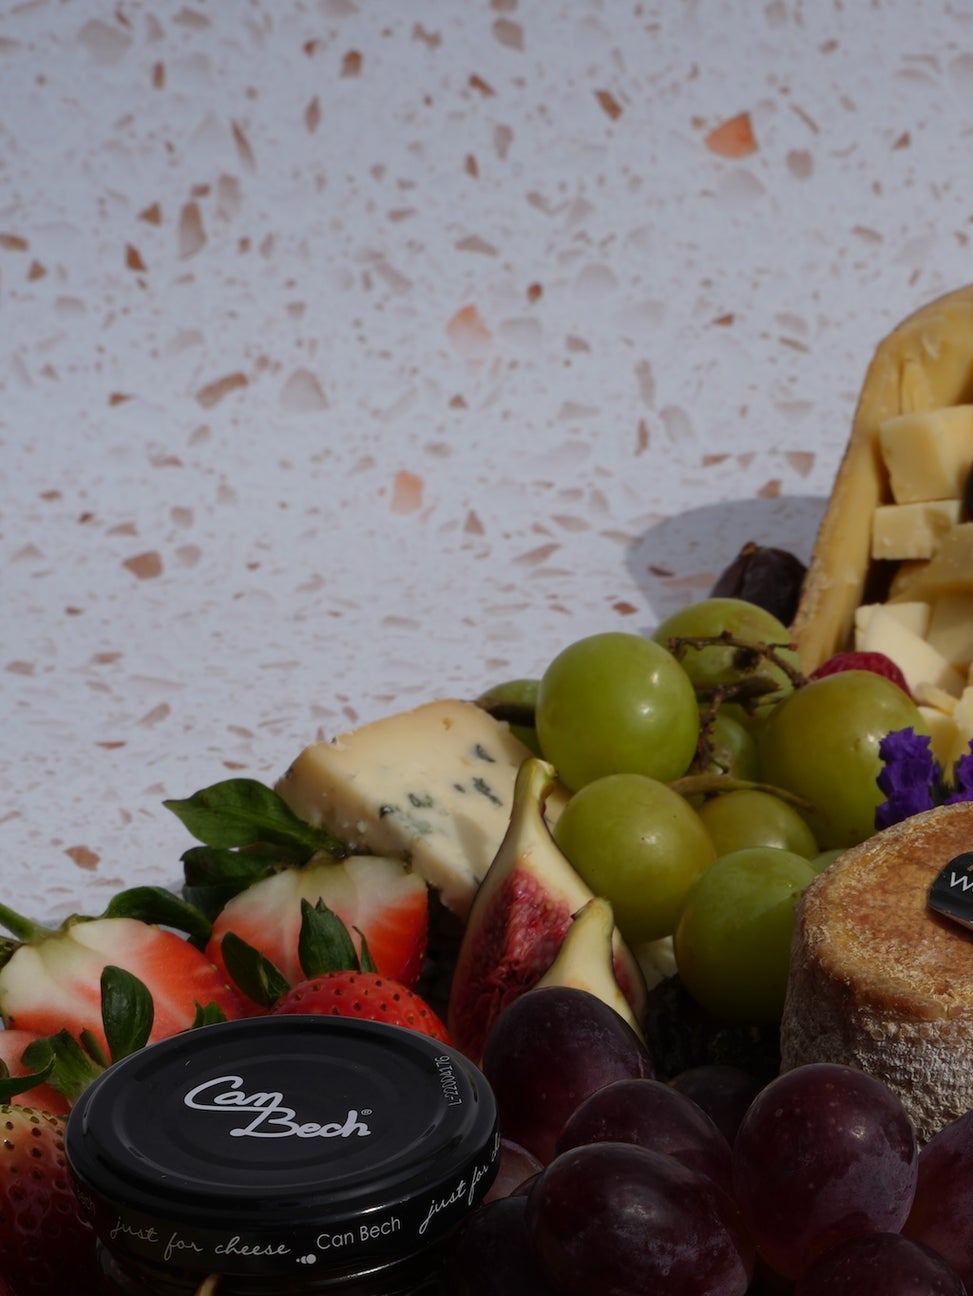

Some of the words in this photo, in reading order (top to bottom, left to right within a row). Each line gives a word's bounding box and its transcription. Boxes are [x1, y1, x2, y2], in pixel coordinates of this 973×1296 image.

[183, 1074, 284, 1113] Can
[110, 1217, 160, 1243] just
[162, 1232, 204, 1262] for
[214, 1235, 292, 1257] cheese
[316, 1232, 355, 1251] Can
[359, 1216, 401, 1243] Bech
[418, 1180, 467, 1236] just
[467, 1164, 490, 1207] for
